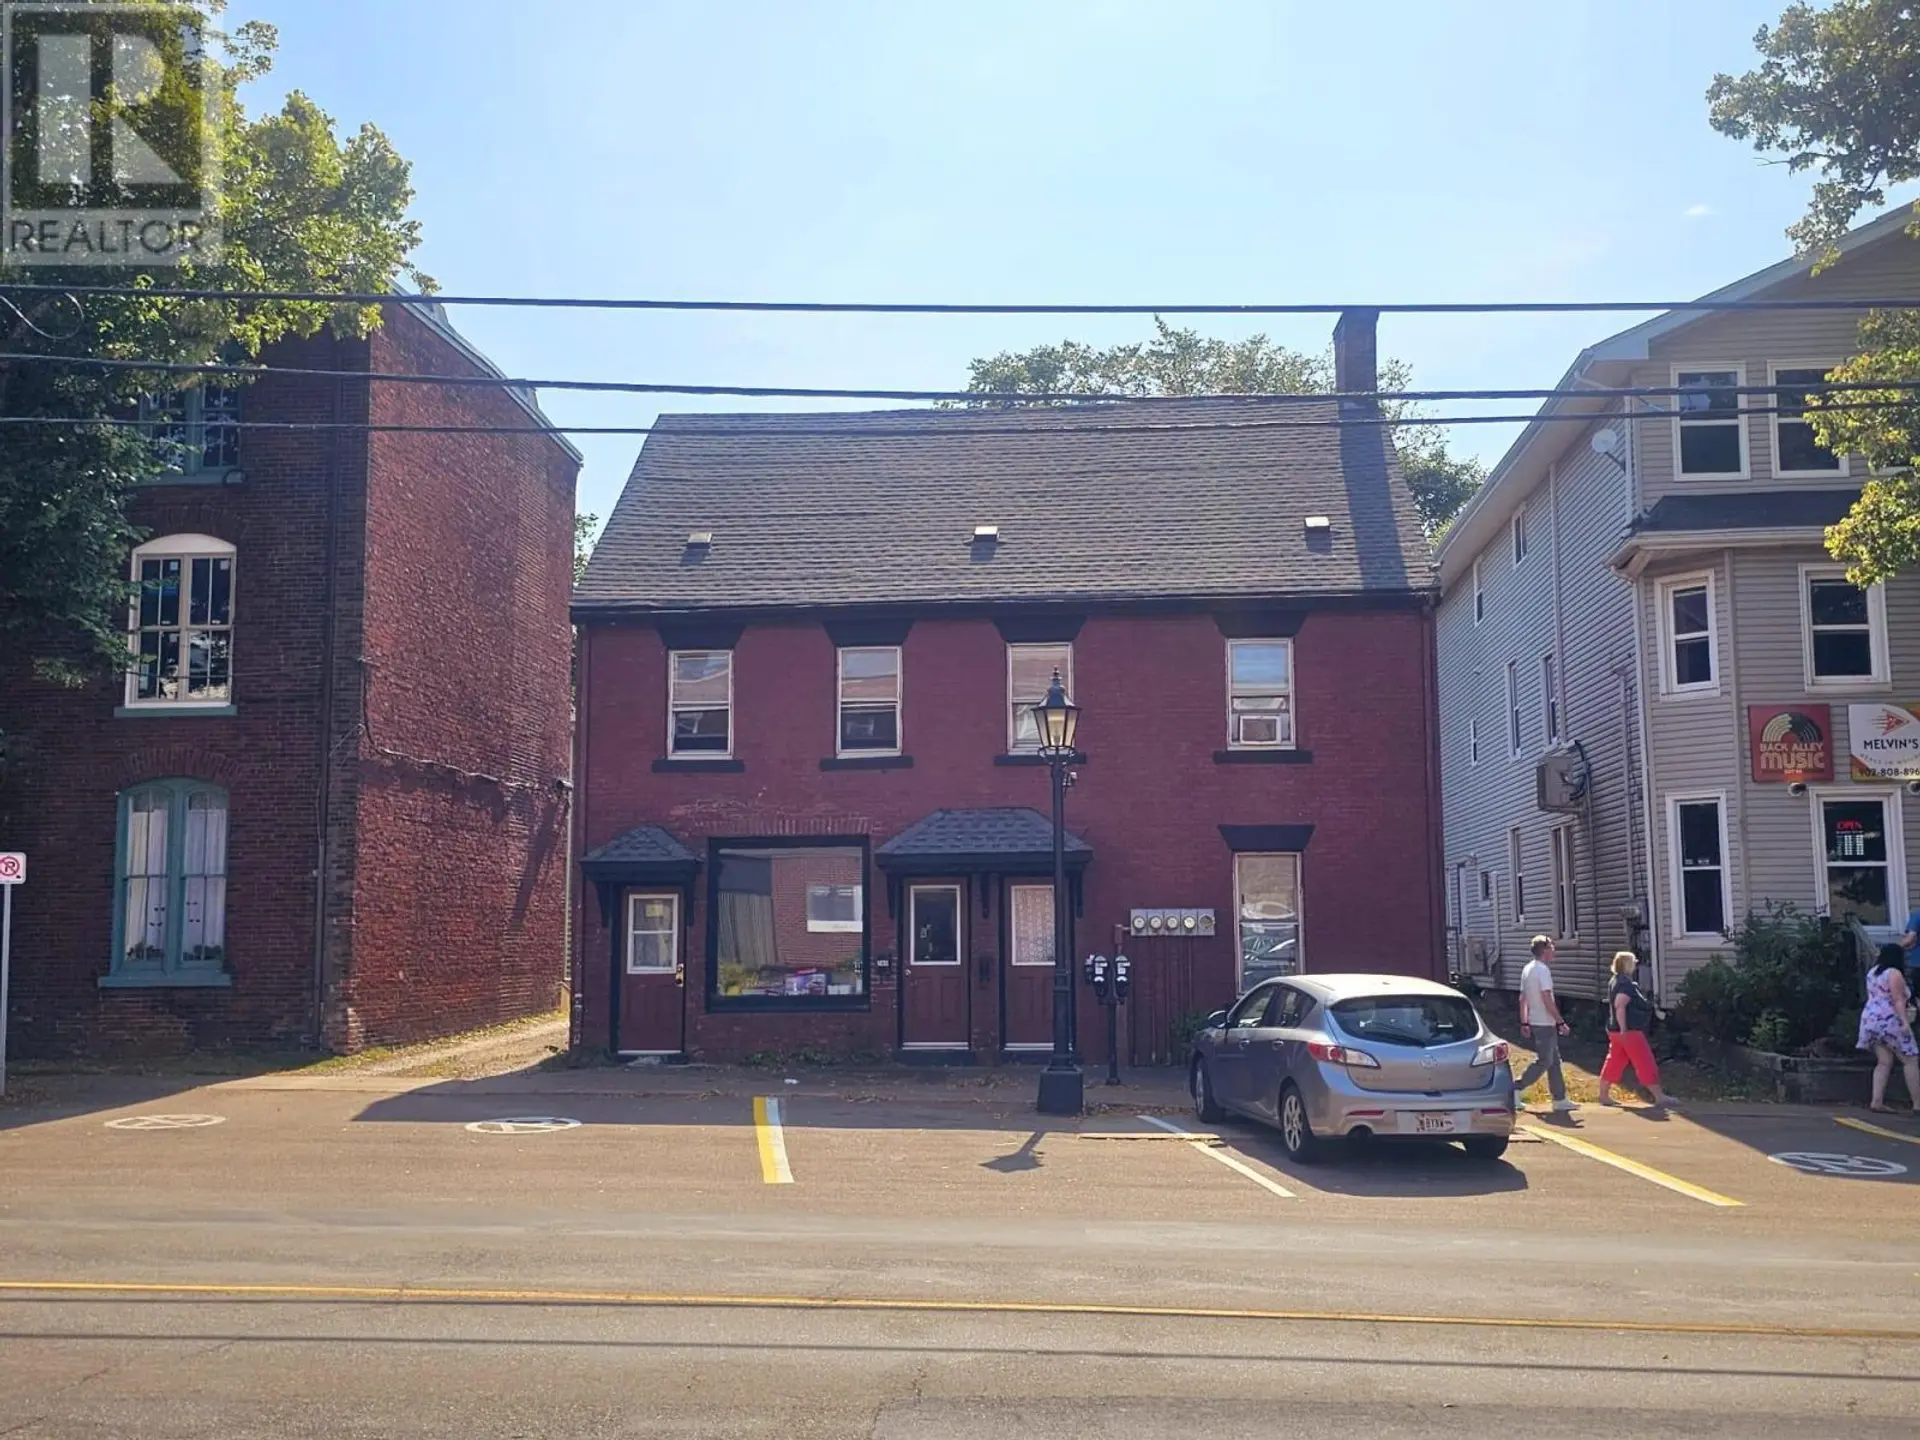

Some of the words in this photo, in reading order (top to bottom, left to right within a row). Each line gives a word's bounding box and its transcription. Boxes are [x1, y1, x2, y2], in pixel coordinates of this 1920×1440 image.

[1760, 743, 1788, 752] BACK
[1791, 742, 1823, 752] ALLEY
[1863, 738, 1919, 750] MELVIN'S
[1760, 752, 1825, 769] MUSIC
